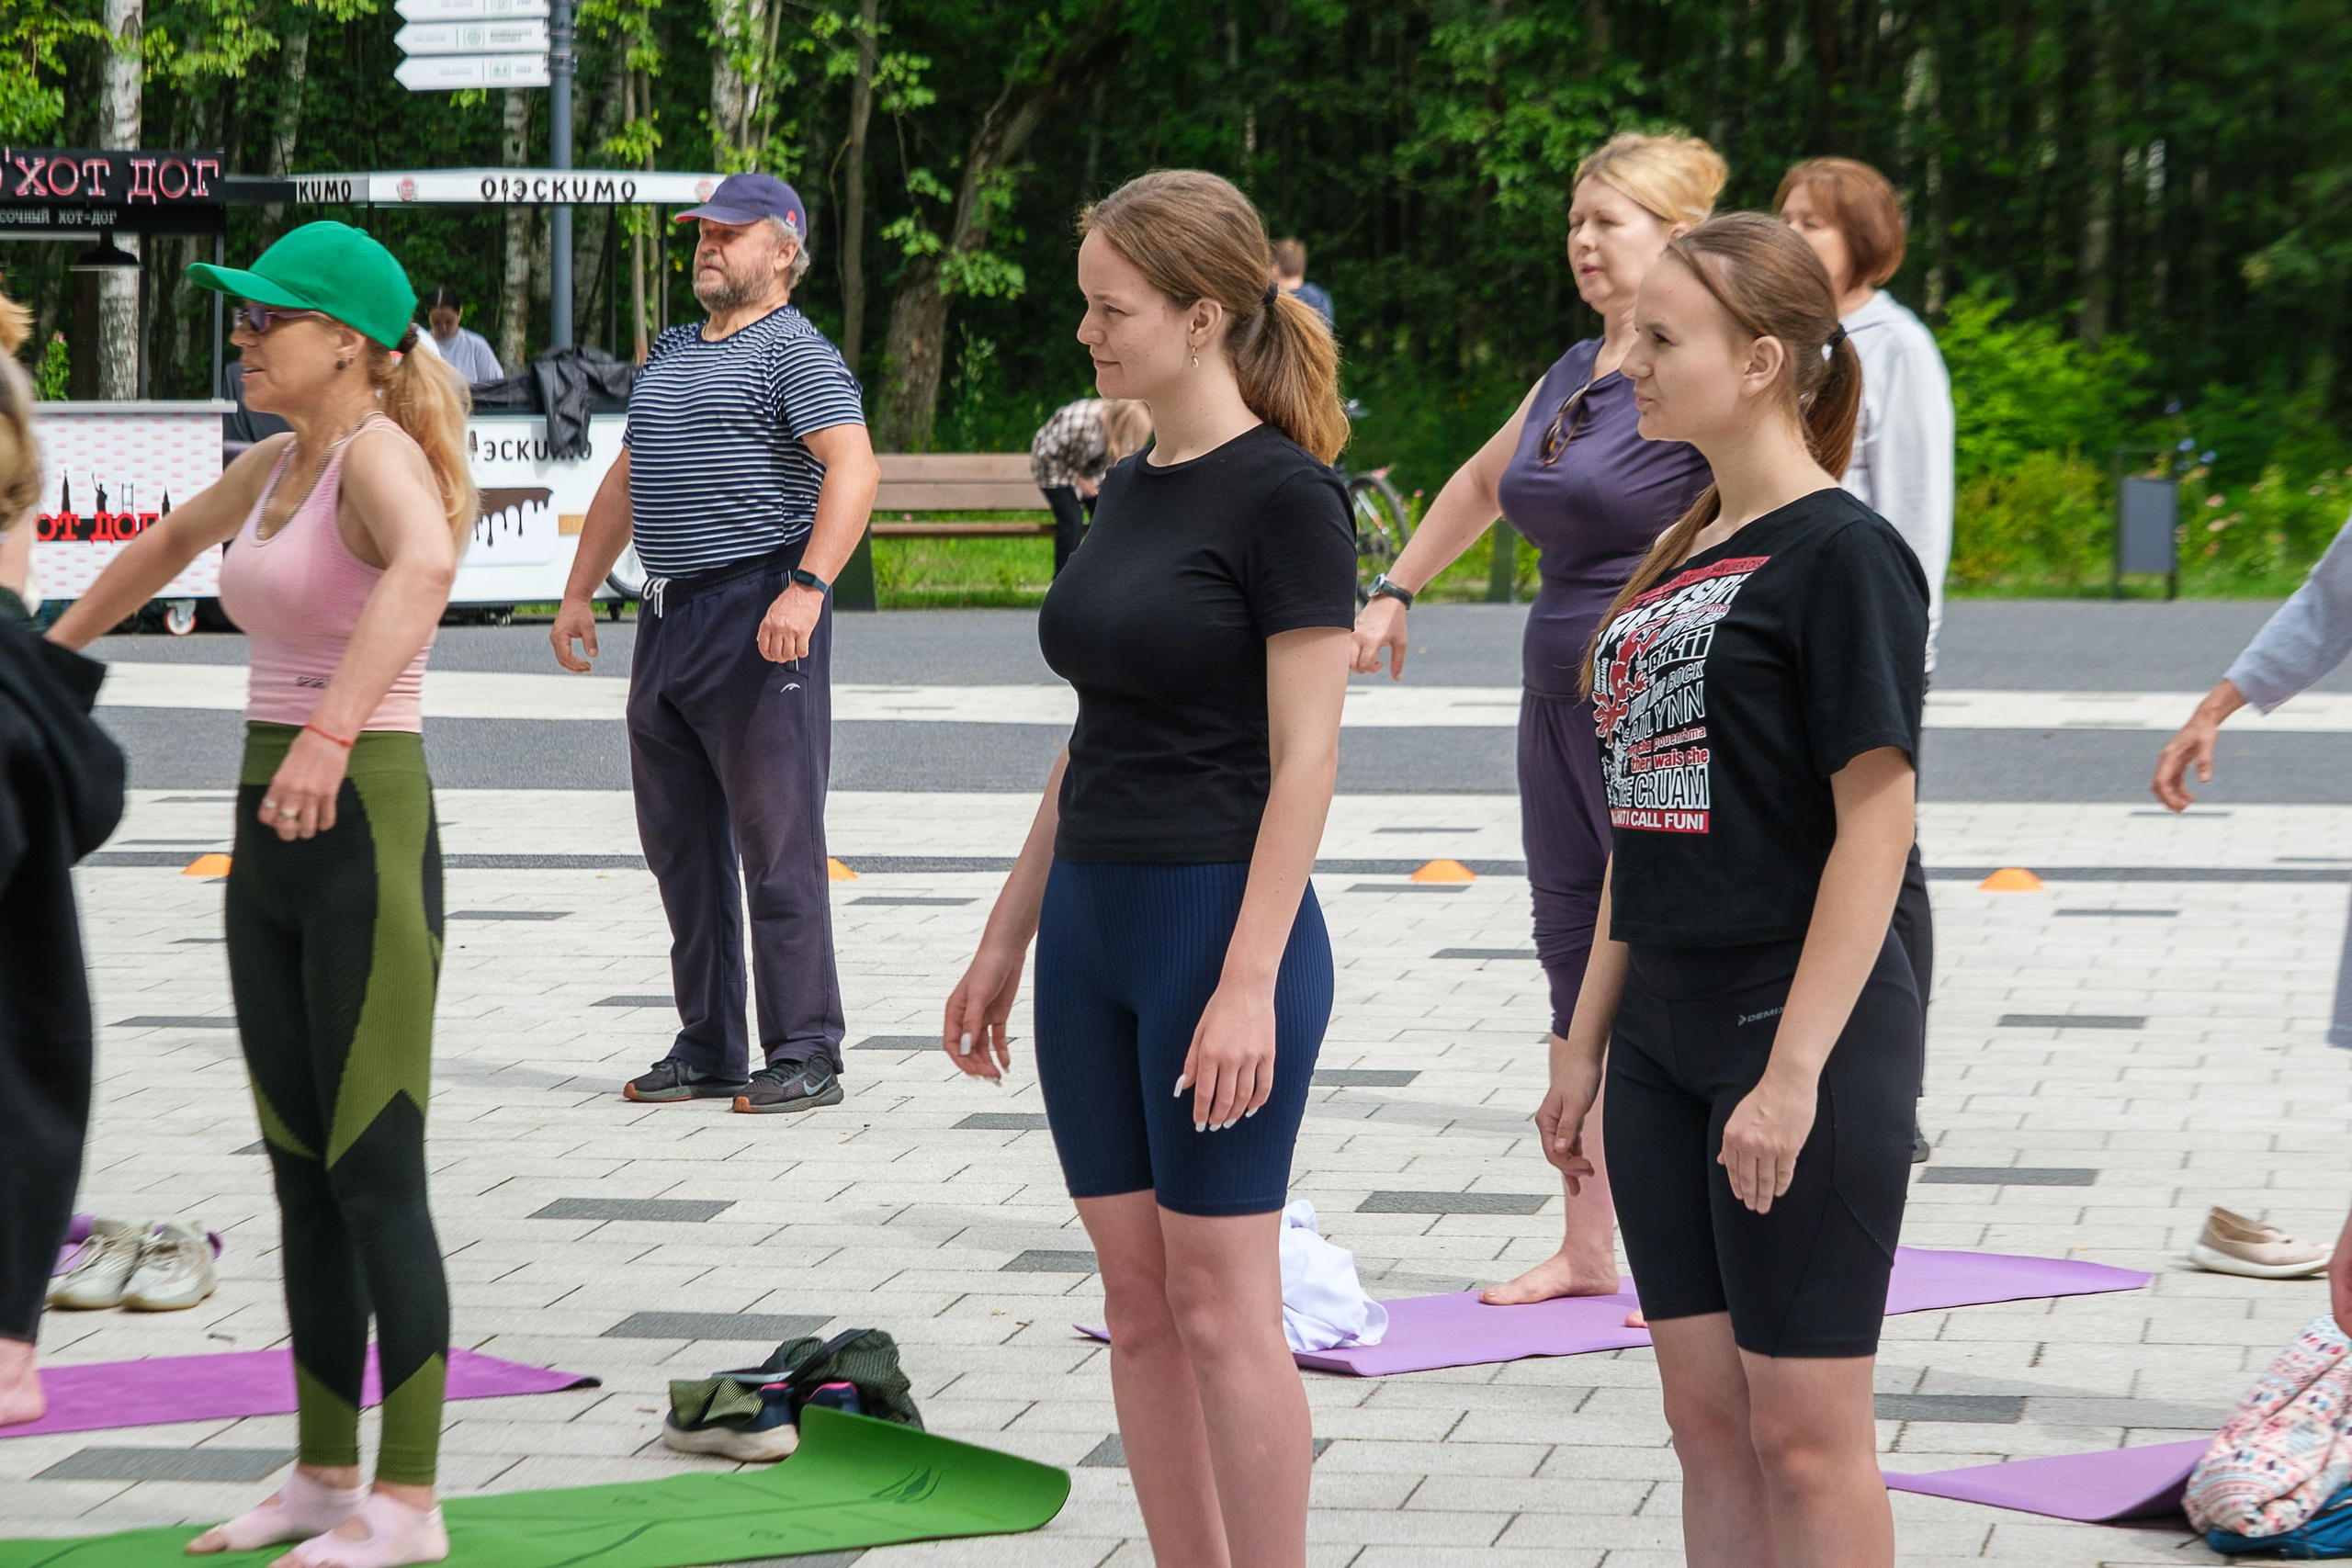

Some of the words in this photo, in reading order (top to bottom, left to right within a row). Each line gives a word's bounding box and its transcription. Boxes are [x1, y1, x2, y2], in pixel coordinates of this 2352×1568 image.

[0, 145, 110, 197] 'ХОТ
[127, 158, 219, 206] ДОГ
[1653, 749, 1685, 770] wais
[1685, 746, 1710, 766] che
[1630, 810, 1662, 828] CALL
